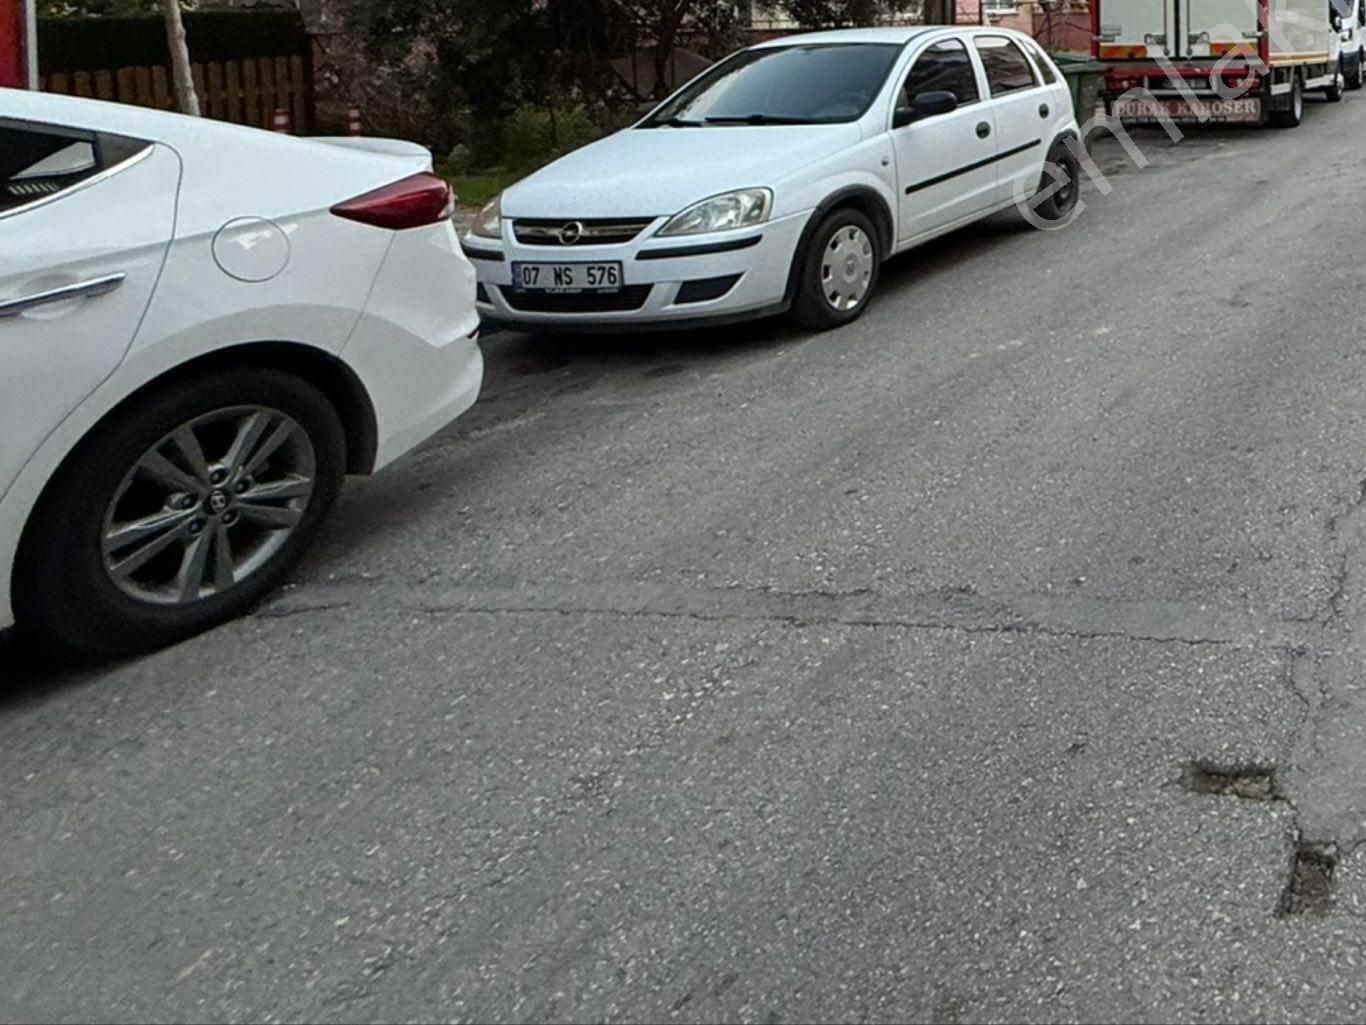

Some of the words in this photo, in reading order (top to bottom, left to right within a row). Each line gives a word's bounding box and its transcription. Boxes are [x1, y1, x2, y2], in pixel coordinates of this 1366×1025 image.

[522, 266, 540, 286] 07
[553, 266, 574, 286] NS
[586, 266, 618, 286] 576
